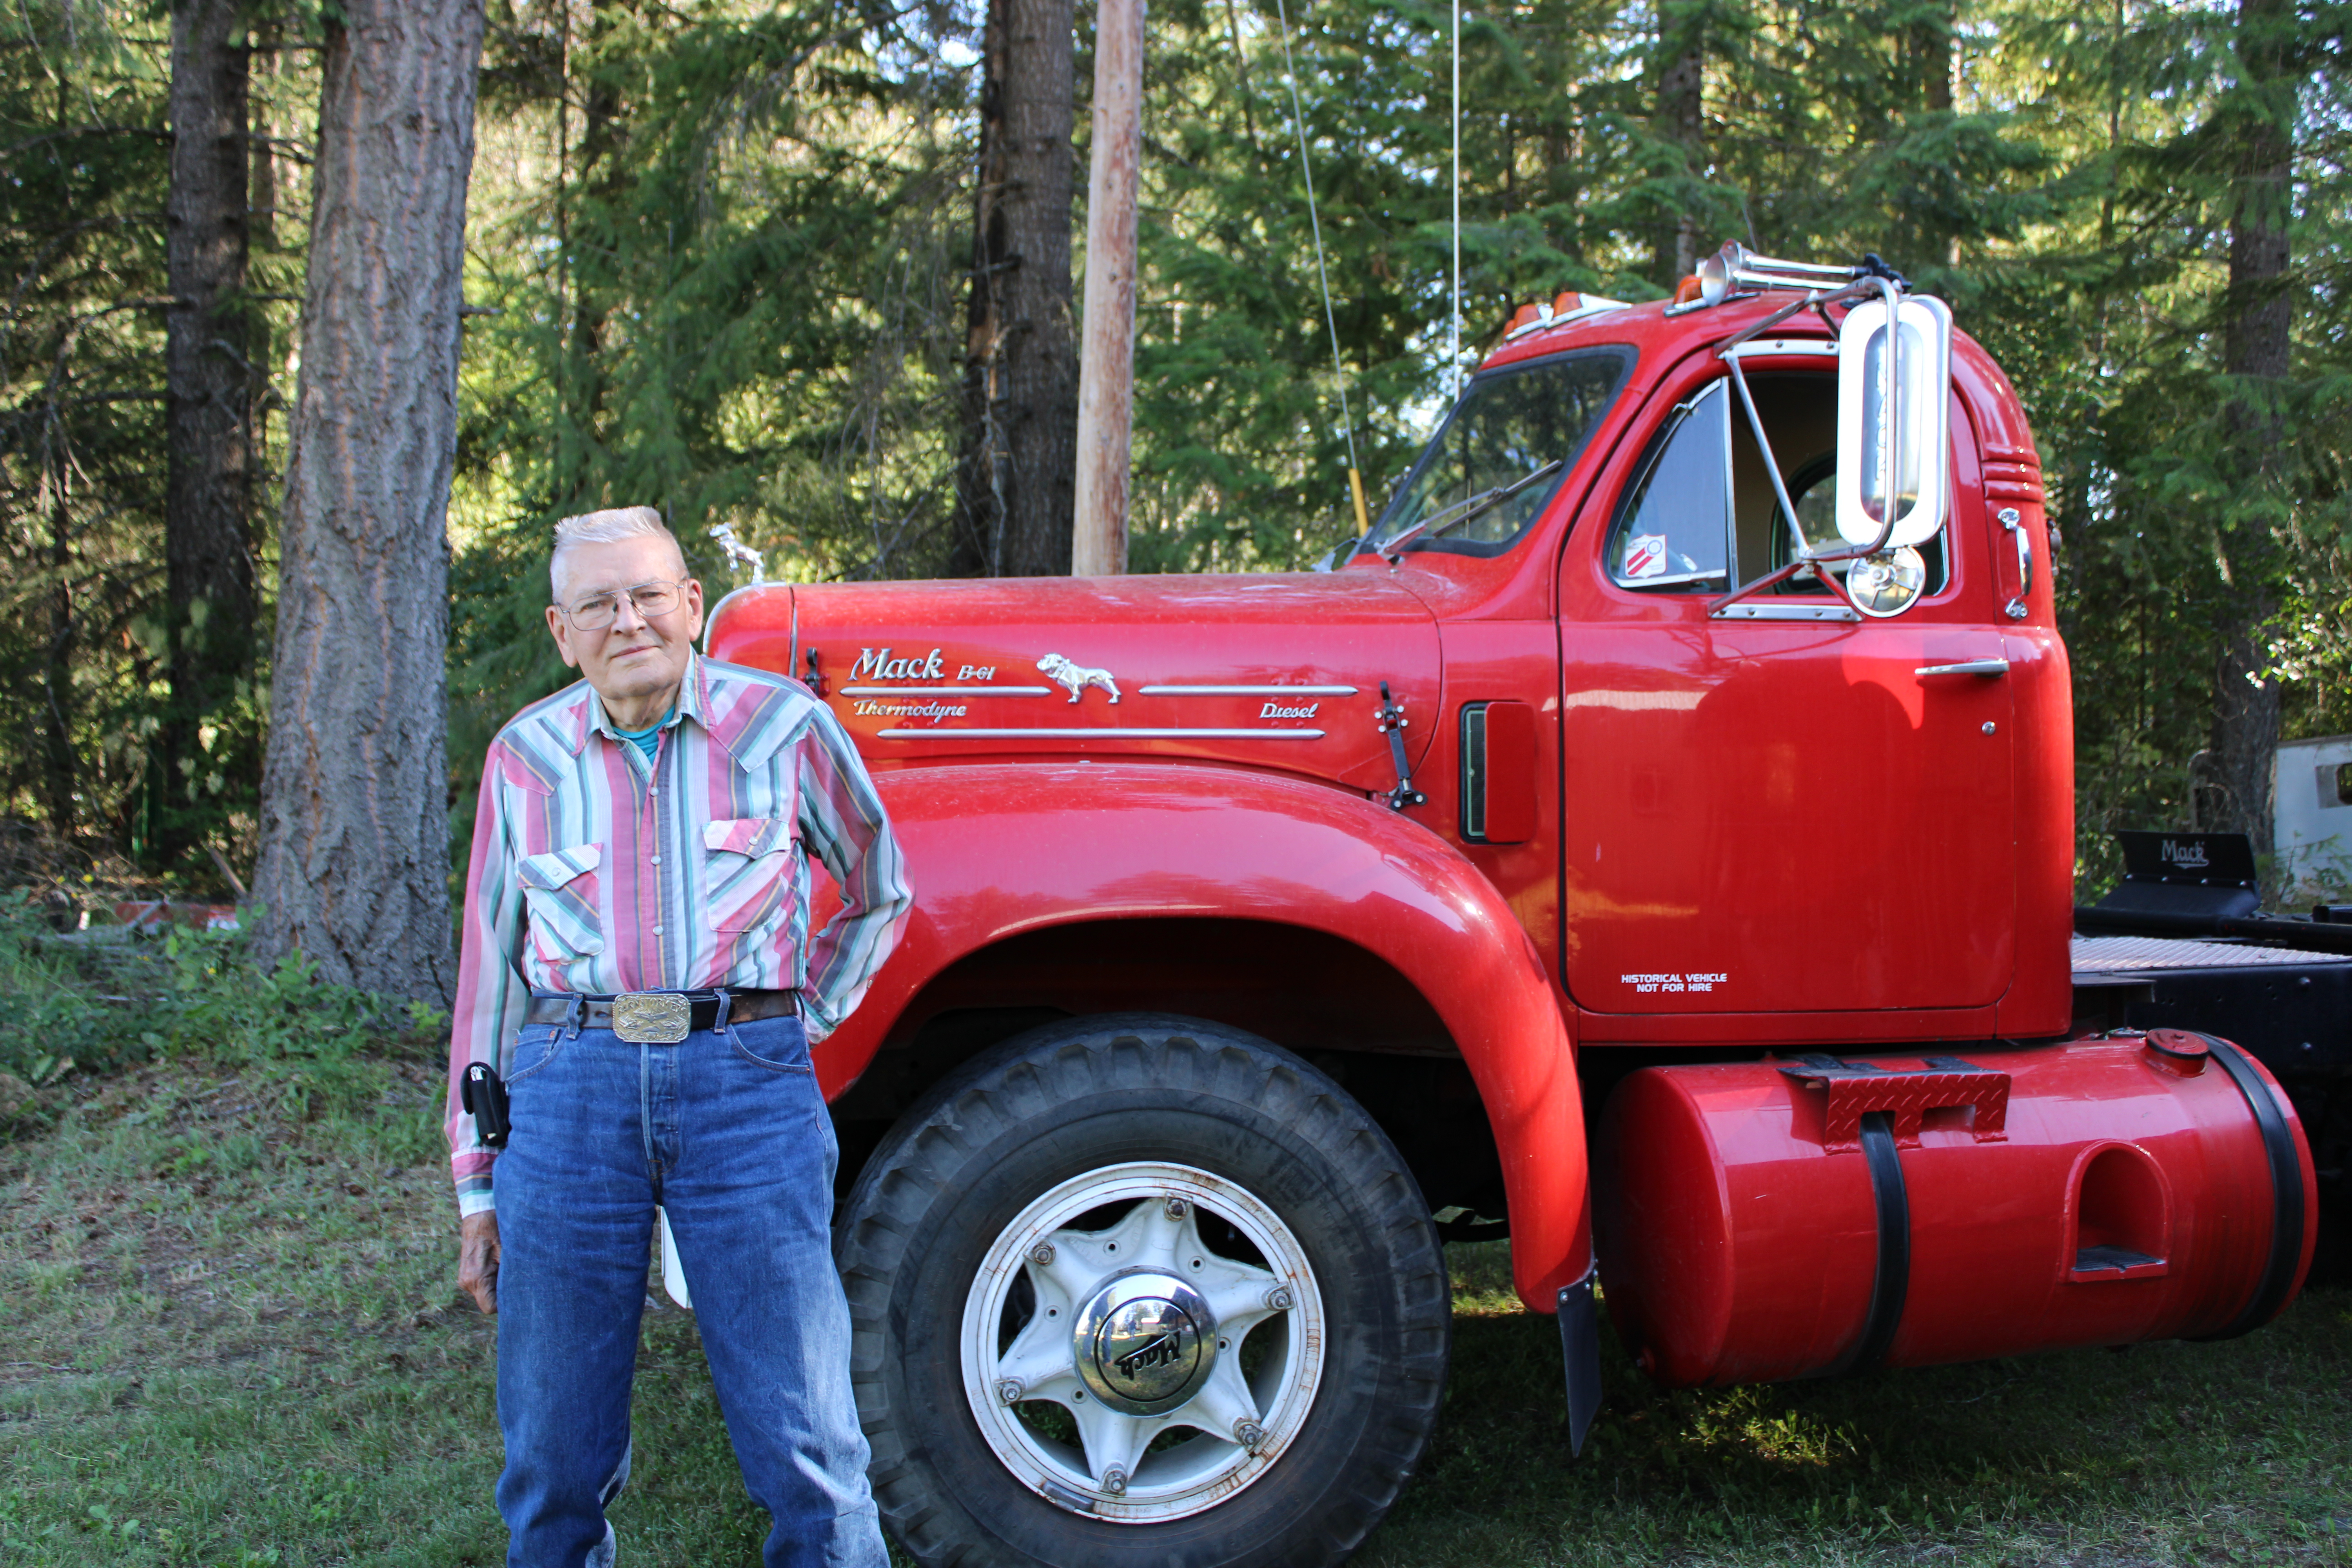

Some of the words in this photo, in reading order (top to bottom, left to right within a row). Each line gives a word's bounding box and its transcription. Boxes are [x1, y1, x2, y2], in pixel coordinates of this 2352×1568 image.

[847, 648, 945, 681] Mack
[853, 699, 967, 724] Thermodyne
[1259, 702, 1319, 719] Diesel
[2160, 840, 2209, 866] Mack
[1621, 974, 1682, 983] HISTORICAL
[1685, 973, 1728, 982] VEHICLE
[1636, 984, 1659, 993] NOT
[1662, 983, 1684, 992] FOR
[1688, 983, 1712, 992] HIRE
[1115, 1330, 1181, 1381] Mack
